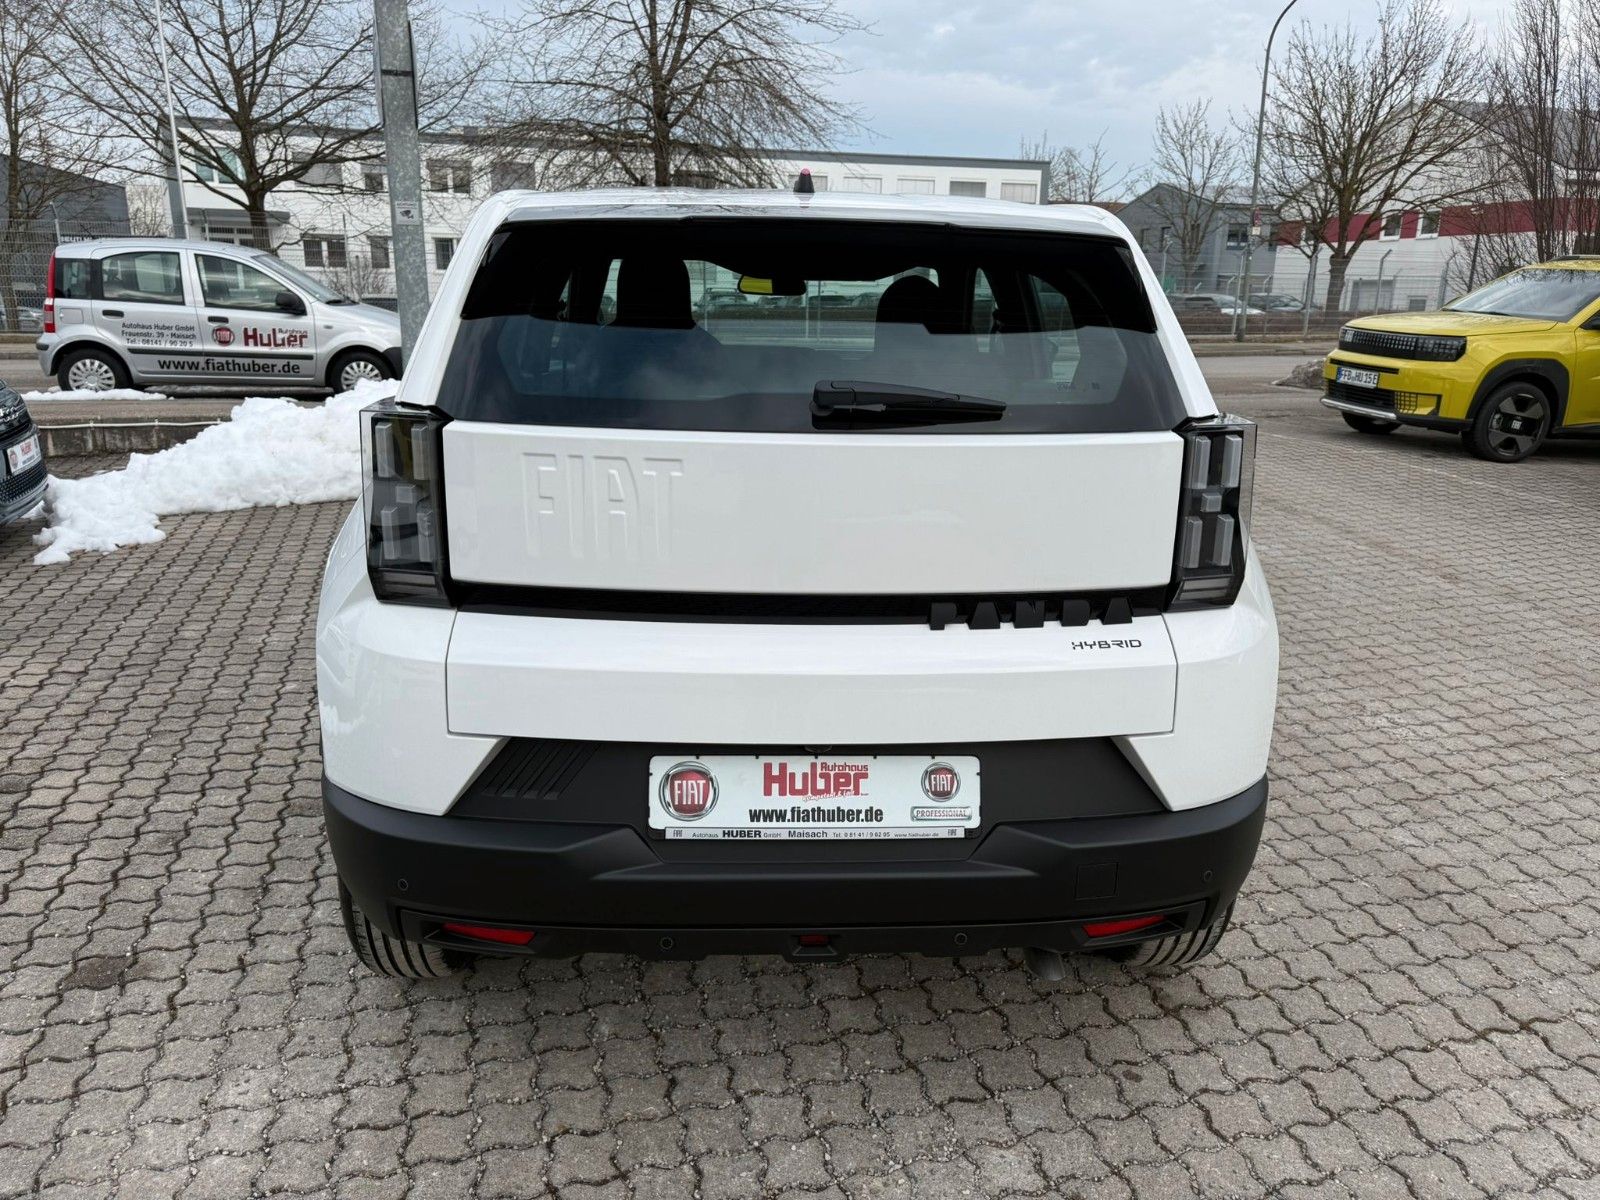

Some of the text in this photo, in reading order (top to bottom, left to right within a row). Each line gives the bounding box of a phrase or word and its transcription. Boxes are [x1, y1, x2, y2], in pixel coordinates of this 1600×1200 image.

[121, 330, 155, 338] Frauenstr.
[158, 358, 300, 373] www.fiathuber.de
[523, 452, 684, 560] FIAT
[1071, 639, 1142, 650] HYBRID
[820, 762, 869, 772] Autohaus
[763, 762, 869, 797] Huber
[930, 774, 952, 792] FIAT
[674, 780, 706, 805] FIAT
[749, 806, 884, 823] www.fiathuber.de
[915, 809, 967, 818] PROFESSIONAL
[722, 829, 762, 838] HUBER
[788, 830, 828, 839] Maisach
